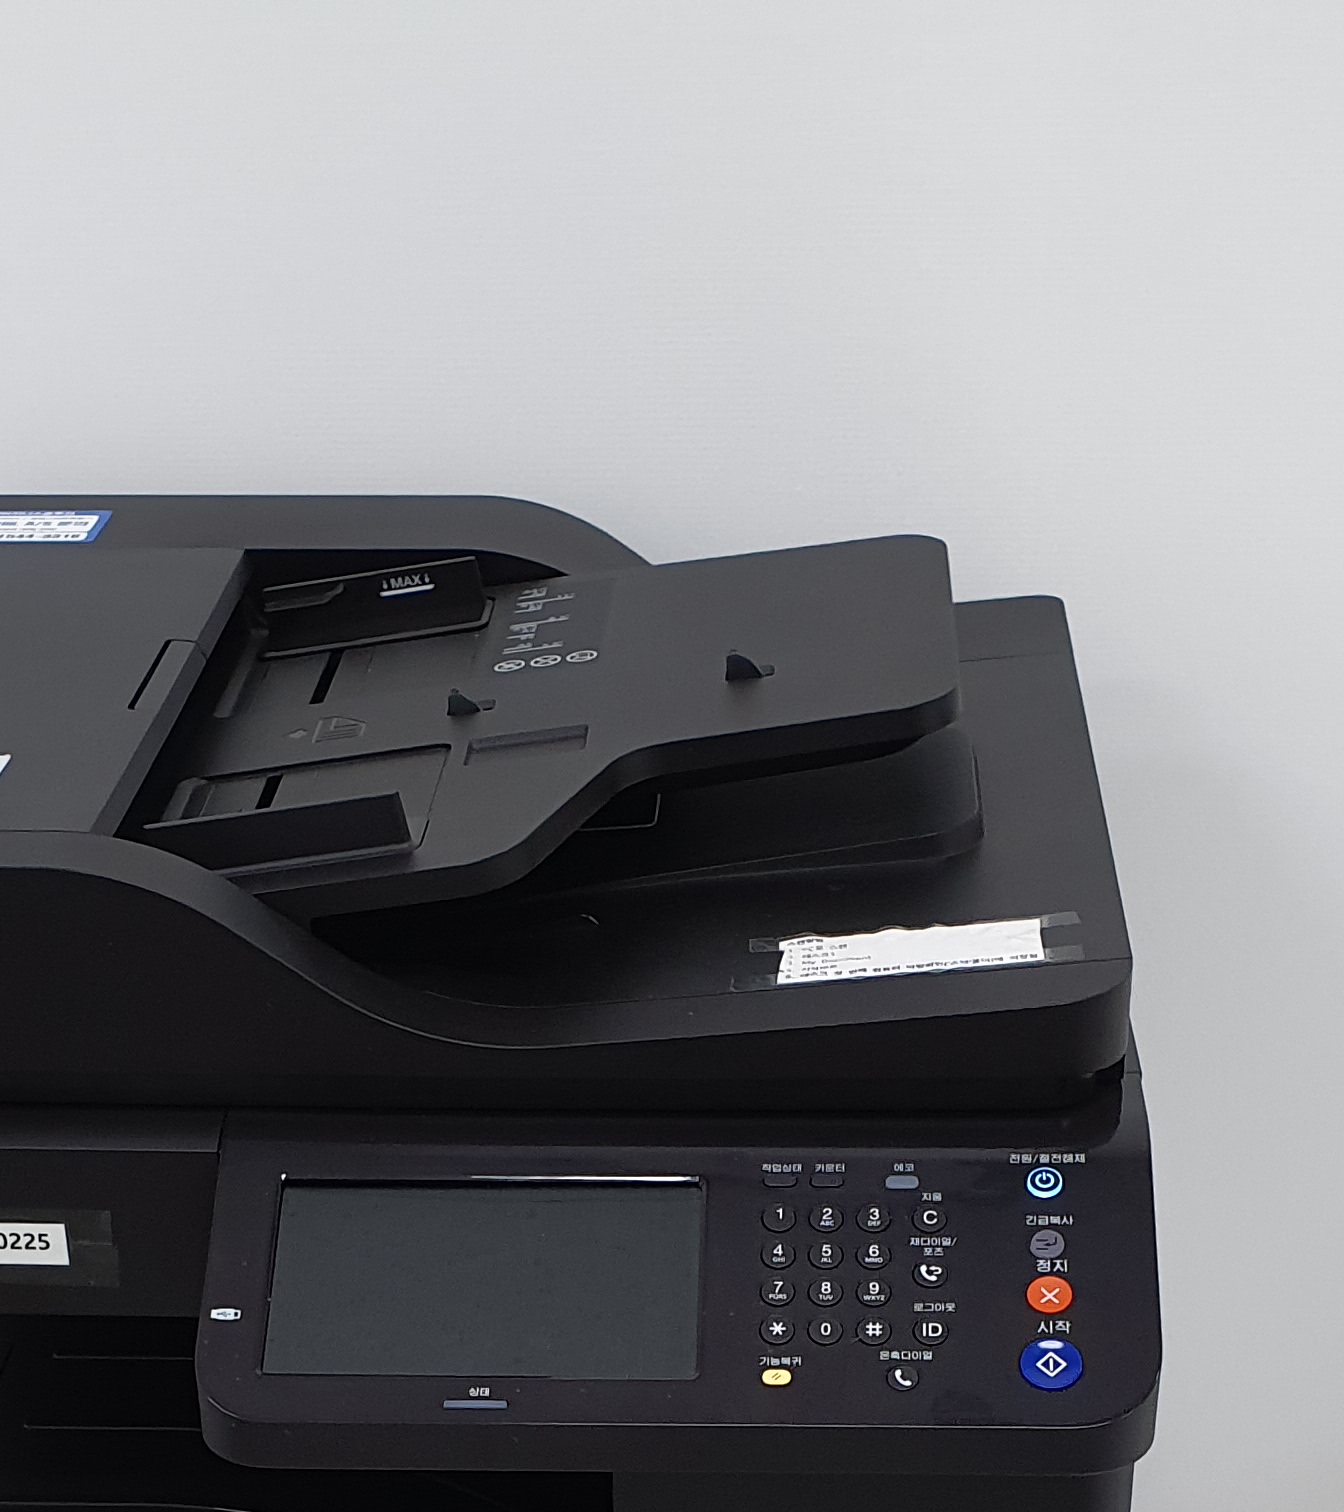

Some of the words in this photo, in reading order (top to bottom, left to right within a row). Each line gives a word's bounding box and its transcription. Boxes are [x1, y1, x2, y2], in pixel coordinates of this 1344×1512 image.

[389, 573, 422, 589] MAX
[775, 1207, 784, 1220] 1
[821, 1207, 833, 1220] 2
[868, 1207, 880, 1220] 3
[922, 1210, 938, 1225] C
[772, 1243, 784, 1256] 4
[821, 1244, 832, 1257] 5
[868, 1244, 880, 1257] 6
[1036, 1259, 1068, 1273] 정지
[773, 1281, 784, 1294] 7
[821, 1281, 832, 1294] 8
[868, 1282, 880, 1294] 9
[820, 1322, 832, 1336] 0
[922, 1322, 943, 1337] ID
[1037, 1320, 1072, 1334] 시작
